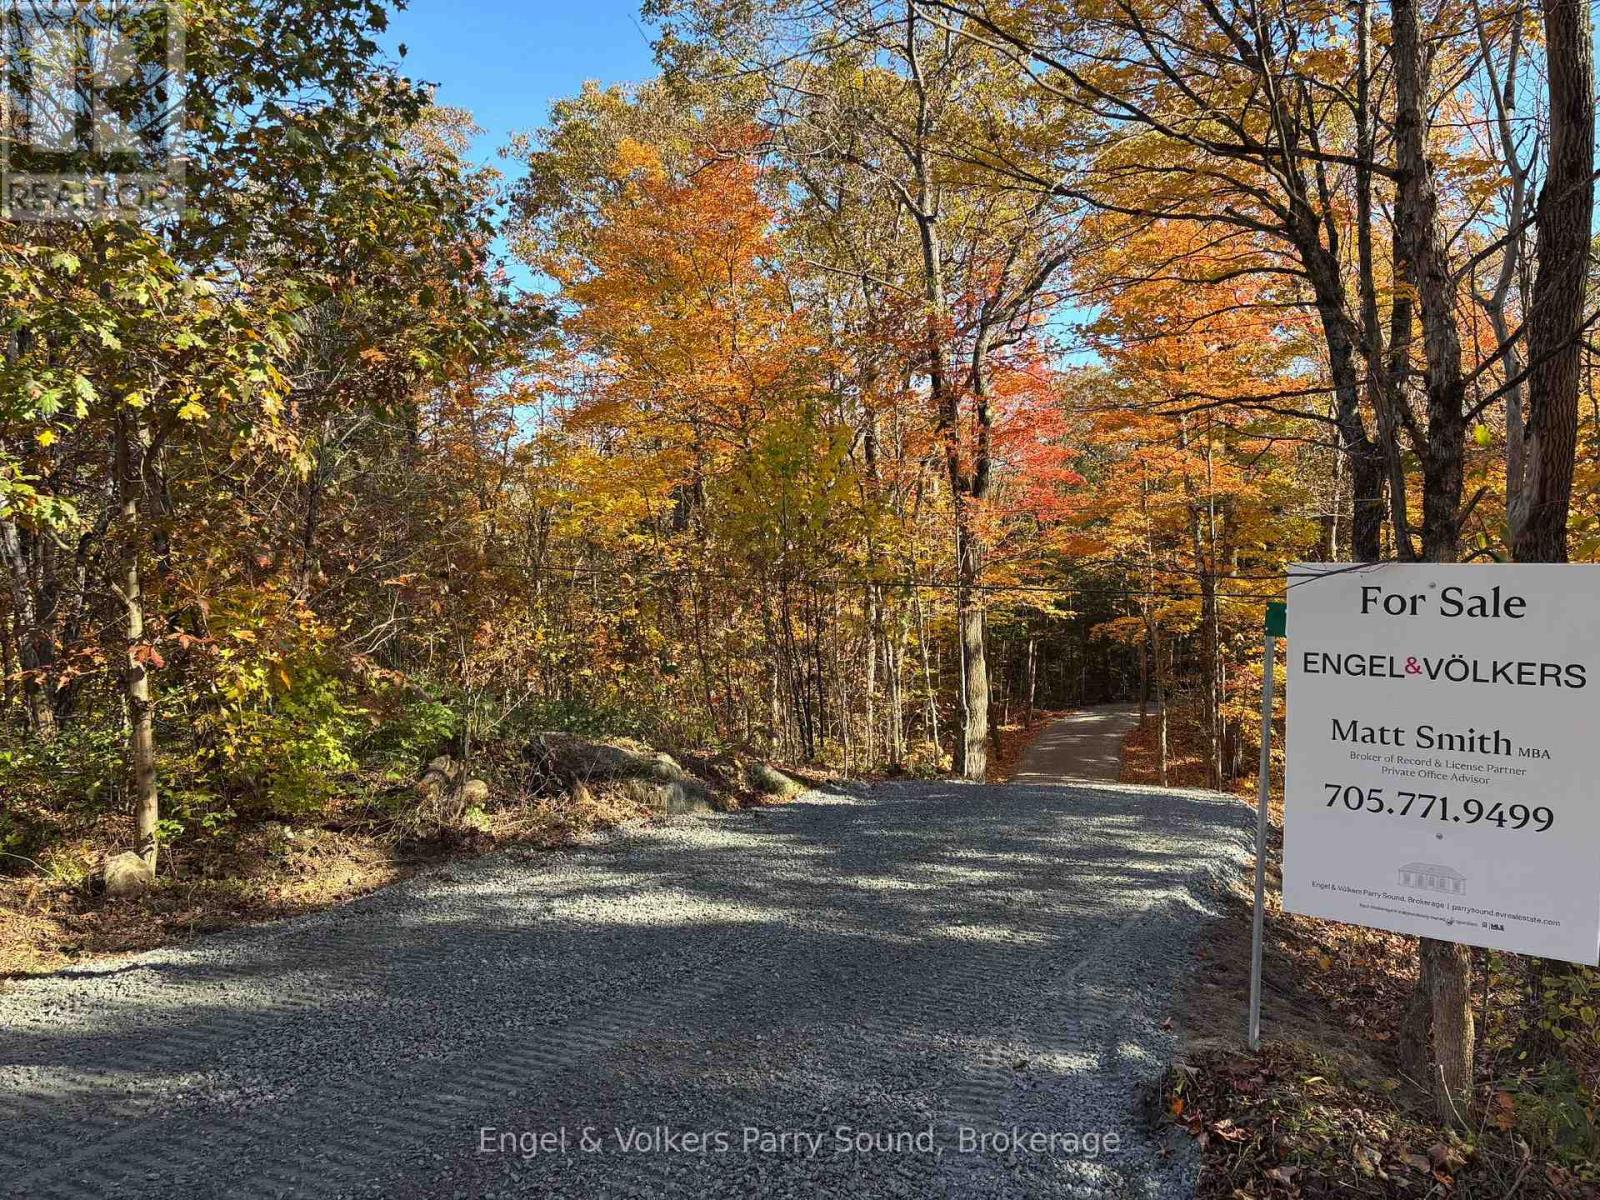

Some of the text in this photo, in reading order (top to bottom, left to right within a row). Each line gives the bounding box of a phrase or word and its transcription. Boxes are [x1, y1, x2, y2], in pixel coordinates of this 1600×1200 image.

[1361, 585, 1526, 618] For Sale
[1331, 719, 1551, 760] Matt Smith MBA
[1350, 751, 1527, 776] Broker of Record & License Partner
[1381, 766, 1490, 785] Private Office Advisor
[1324, 783, 1555, 833] 705.771.9499
[1311, 880, 1330, 890] Engel
[1363, 889, 1382, 899] Parry
[1408, 896, 1445, 909] Brokerage
